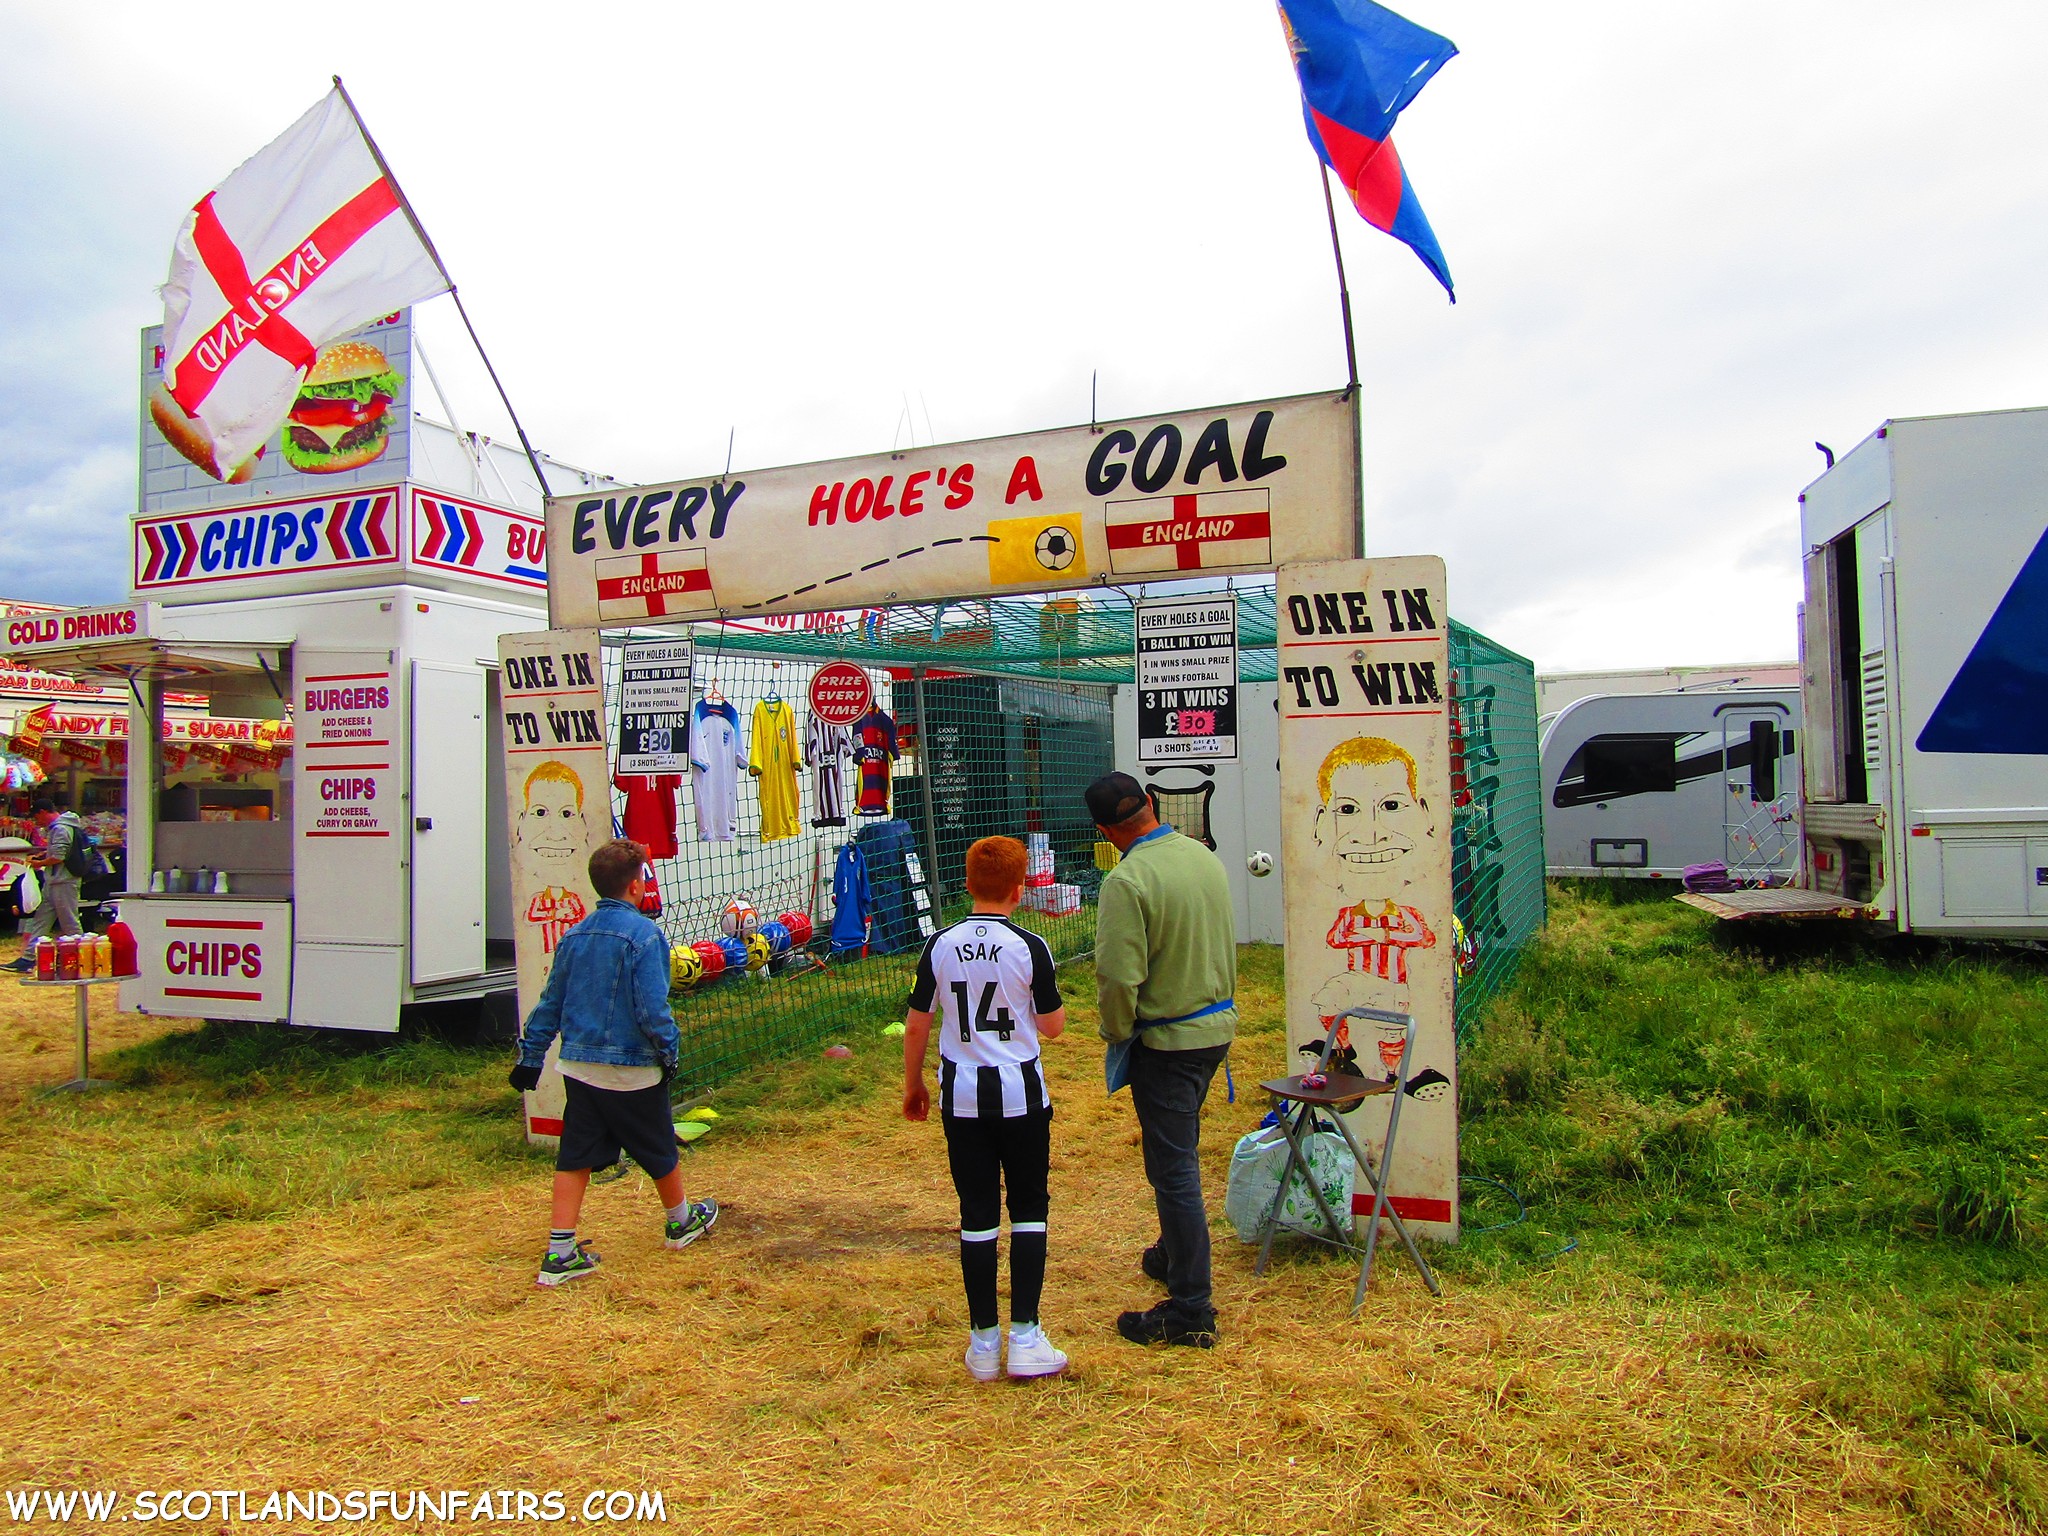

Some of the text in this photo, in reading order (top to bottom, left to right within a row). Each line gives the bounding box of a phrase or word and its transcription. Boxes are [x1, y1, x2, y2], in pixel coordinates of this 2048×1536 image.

[572, 410, 1288, 554] EVERY HOLE'S A GOAL
[200, 507, 324, 573] CHIPS
[1142, 519, 1235, 545] ENGLAND
[621, 574, 685, 596] ENGLAND
[1141, 610, 1230, 627] EVERY HOLES A GOAL
[1287, 588, 1436, 636] ONE IN
[8, 610, 137, 645] COLD DRINKS
[1141, 634, 1231, 650] 1 BALL IN TO WIN
[626, 647, 689, 661] EVERY HOLES A GOAL
[1143, 656, 1230, 668] 1 IN WINS SMALL PRIZE
[505, 652, 595, 690] ONE IN
[625, 667, 689, 680] 1 BALL IN TO WIN
[1143, 672, 1219, 684] 2 IN WINS FOOTBALL
[818, 676, 863, 686] PRIZE
[1283, 661, 1442, 708] TO WIN
[305, 686, 389, 711] BURGERS
[626, 688, 629, 696] 1
[817, 690, 865, 701] EVERY
[1145, 688, 1229, 709] 3 IN WINS
[653, 699, 678, 707] FOOTBALL
[821, 705, 860, 715] TIME
[44, 715, 107, 735] ANDY
[188, 720, 251, 739] SUGAR
[322, 716, 372, 727] ADD CHEESE &
[505, 710, 602, 745] TO WIN
[625, 713, 685, 730] 3 IN WINS
[322, 728, 372, 738] FRIED ONIONS
[61, 740, 98, 761] NOUGAT
[233, 746, 265, 762] FUDGE
[1154, 743, 1191, 755] (3 SHOTS
[638, 758, 657, 767] SHOTS
[321, 778, 376, 800] CHIPS
[324, 807, 371, 817] ADD CHEESE,
[317, 818, 378, 828] CURRY OR GRAVY
[166, 940, 262, 978] CHIPS
[955, 942, 1003, 963] ISAK
[950, 981, 1015, 1042] 14
